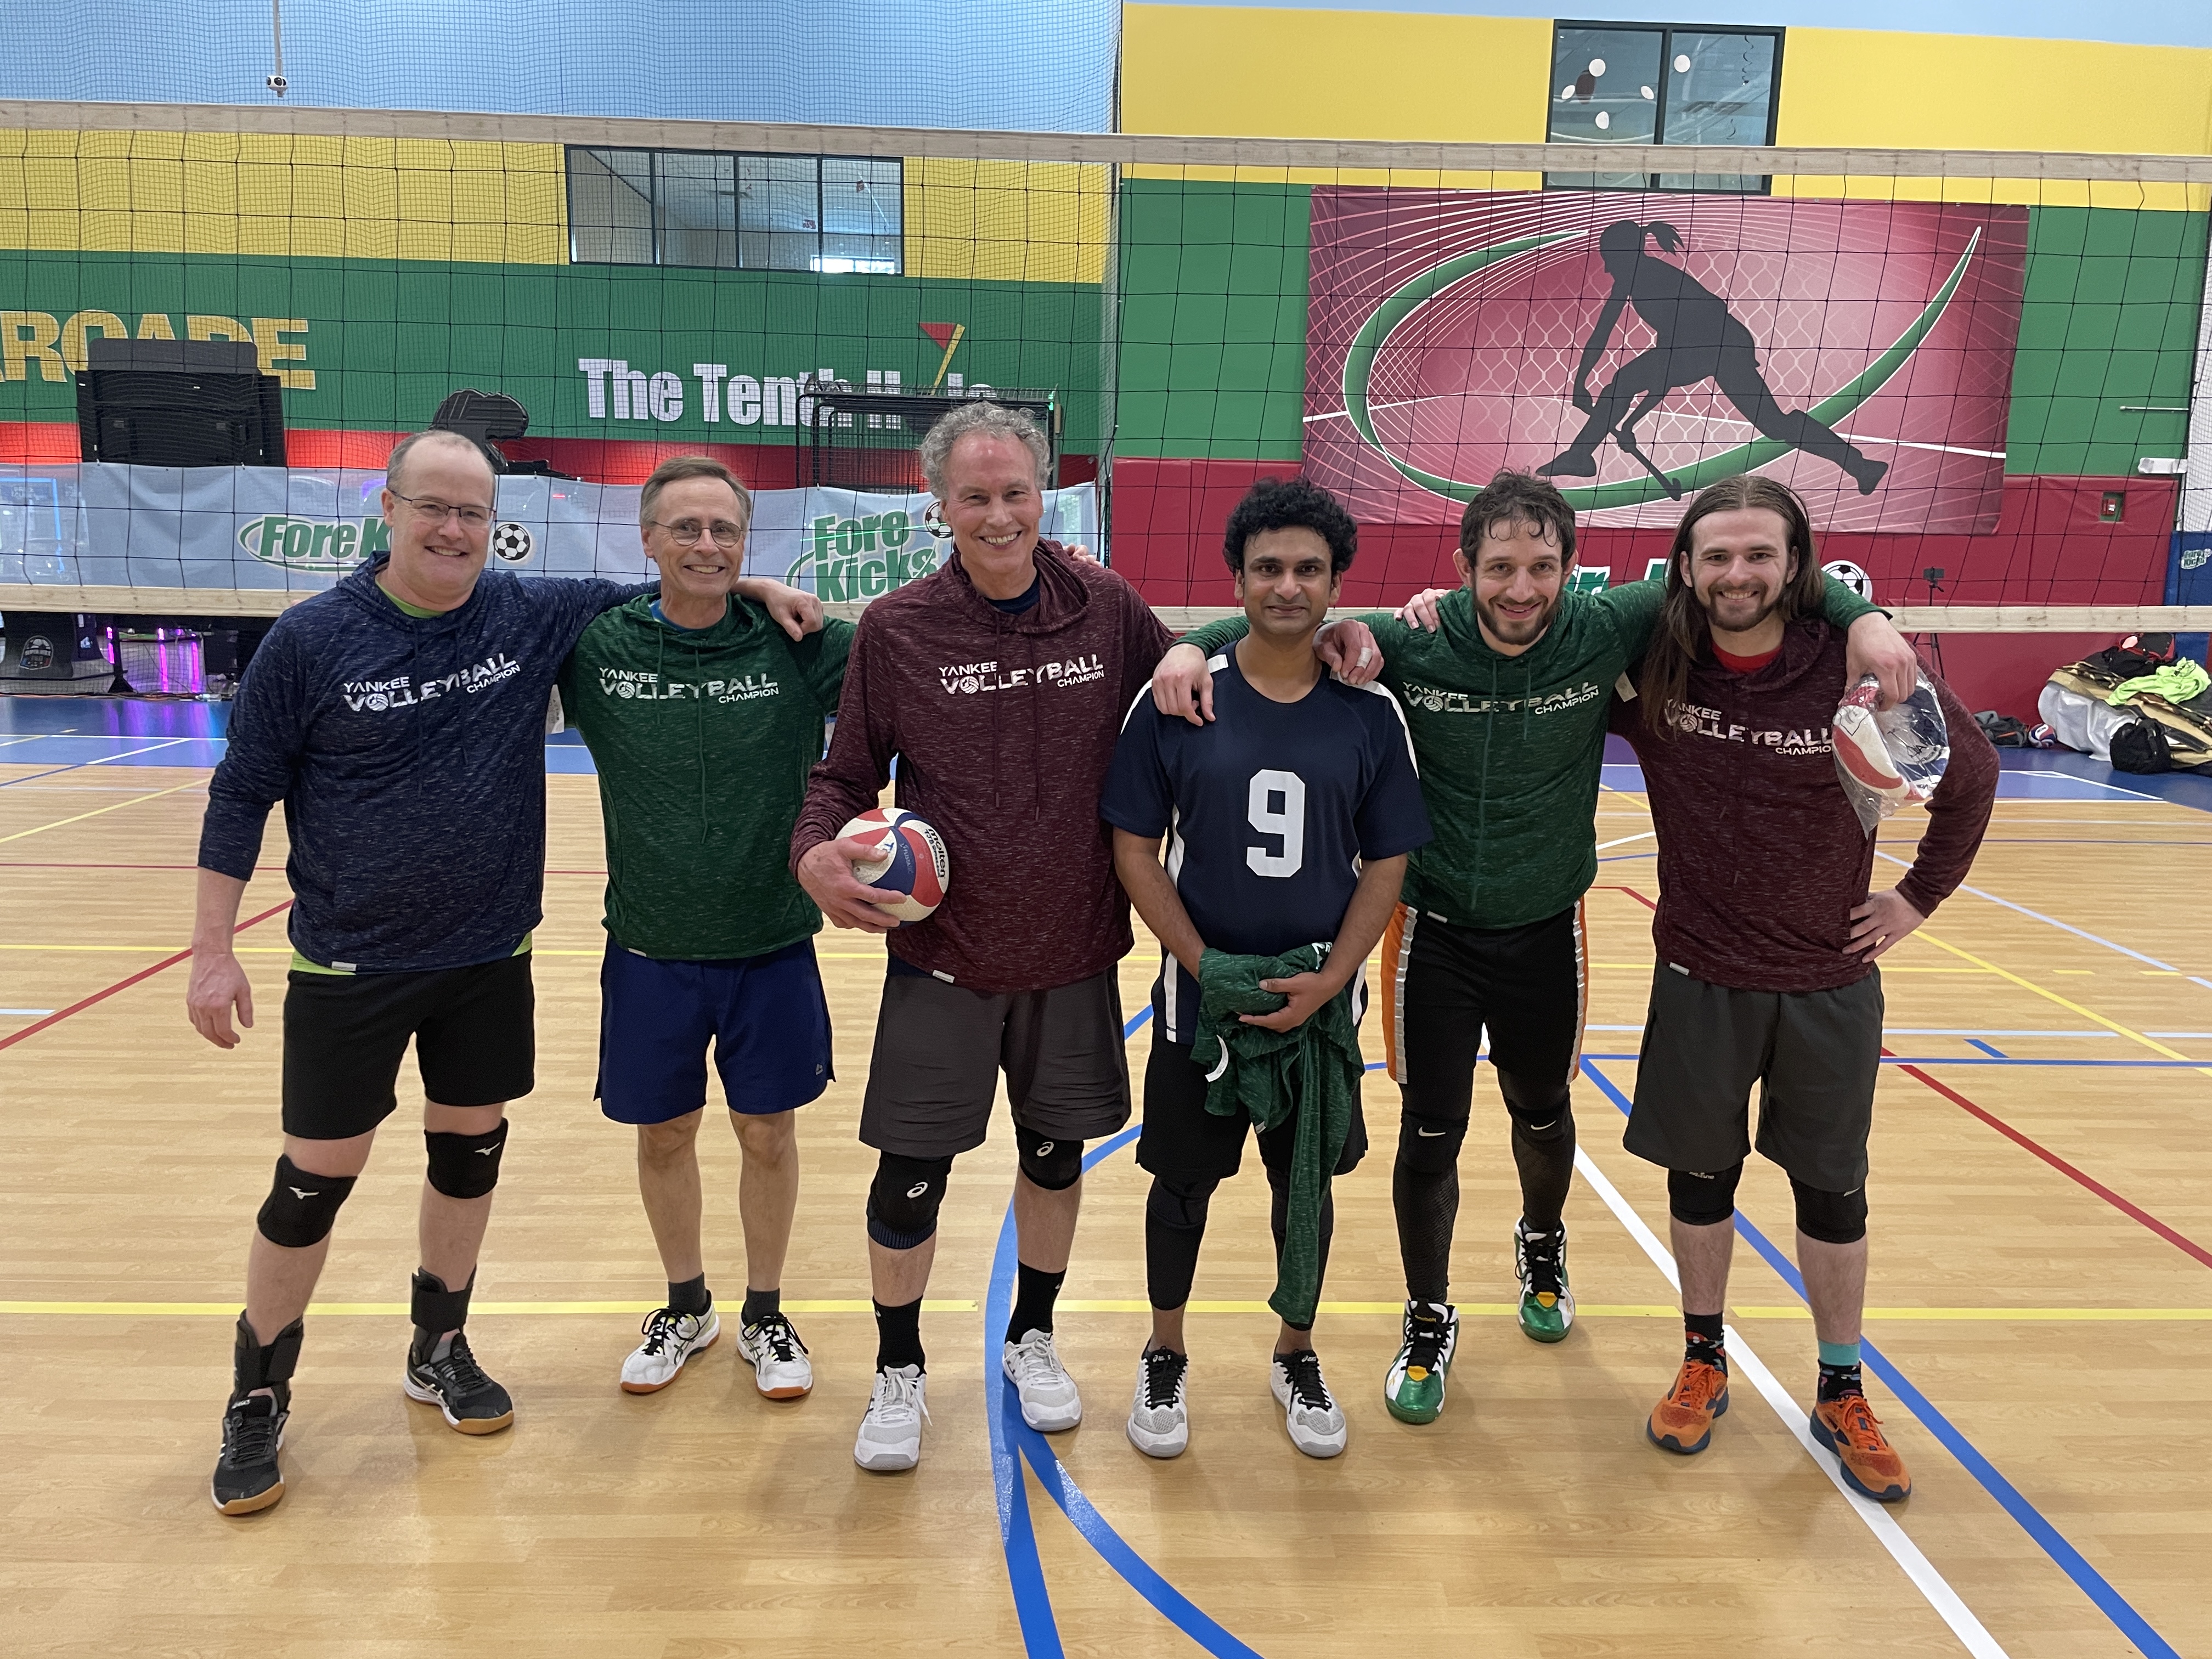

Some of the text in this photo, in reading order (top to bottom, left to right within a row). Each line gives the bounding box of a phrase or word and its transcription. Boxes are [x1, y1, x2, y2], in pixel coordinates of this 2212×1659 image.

[578, 358, 684, 422] The
[260, 516, 357, 558] Fore
[814, 511, 910, 561] Fore
[466, 664, 521, 694] CHAMPION
[599, 667, 658, 683] YANKEE
[939, 661, 997, 677] YANKEE
[940, 653, 1103, 695] VOLLEYBALL
[1057, 669, 1105, 688] CHAMPION
[343, 676, 410, 693] YANKEE
[599, 673, 778, 699] VOLLEYBALL
[718, 687, 780, 704] CHAMPION
[1534, 689, 1600, 715] CHAMPION
[1775, 744, 1832, 755] CHAMPIO
[1246, 769, 1306, 878] 9
[927, 828, 946, 878] molten
